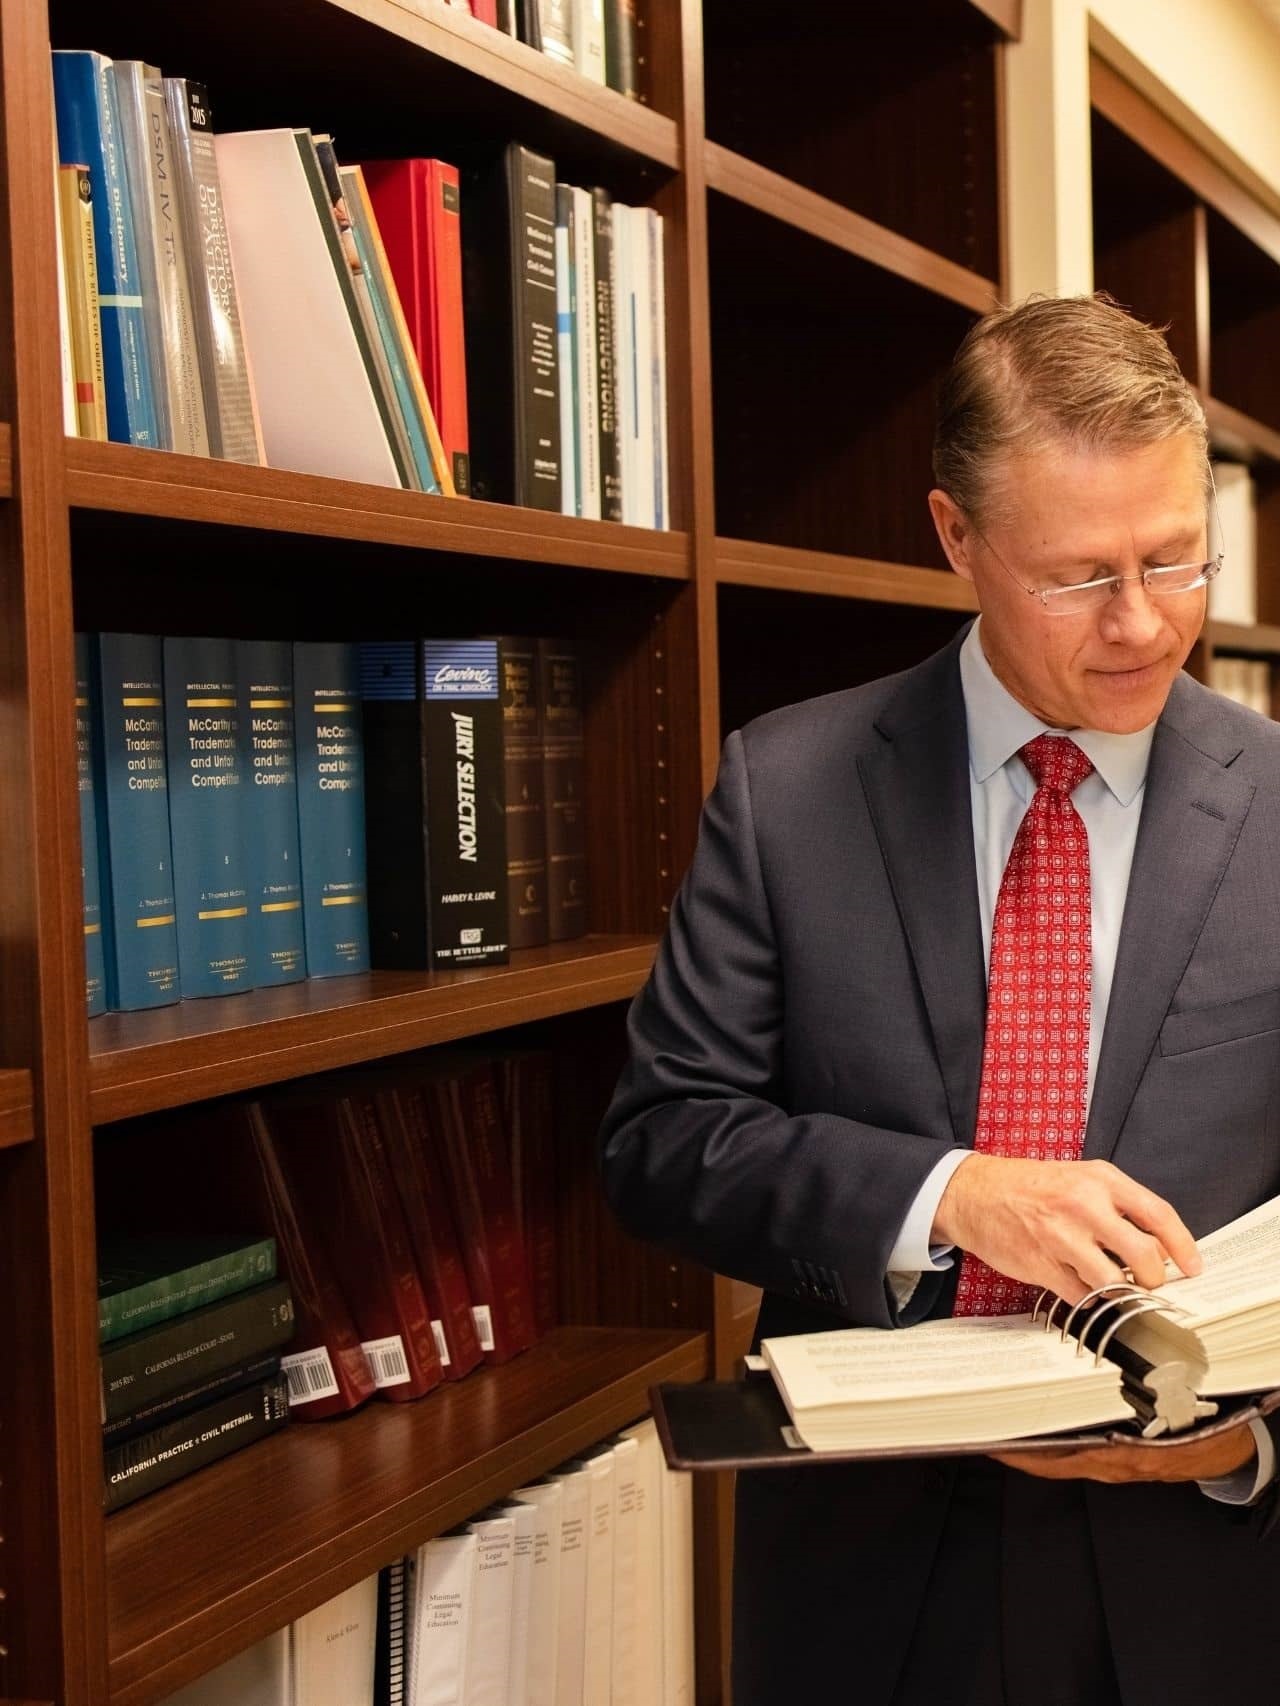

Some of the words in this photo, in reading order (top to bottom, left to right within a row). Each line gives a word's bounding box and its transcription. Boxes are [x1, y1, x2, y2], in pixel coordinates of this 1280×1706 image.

[199, 184, 208, 217] OF
[112, 187, 129, 284] Dictionary
[206, 185, 232, 322] DIRECTORY
[94, 340, 102, 383] ORDER
[434, 664, 493, 684] Levine
[450, 711, 475, 761] JURY
[128, 757, 146, 770] and
[190, 756, 212, 769] and
[254, 755, 273, 768] and
[318, 761, 338, 773] and
[456, 760, 479, 863] SELECTION
[207, 890, 230, 900] Thomas
[474, 890, 497, 902] LEVINE
[209, 957, 246, 969] THOMSON
[111, 1456, 158, 1484] CALIFORNIA
[158, 1439, 194, 1463] PRACTICE
[201, 1428, 221, 1442] CIVIL
[220, 1412, 254, 1434] PRETRIAL
[485, 1551, 503, 1562] Legal
[478, 1560, 509, 1571] Education
[429, 1592, 461, 1602] Minimum
[426, 1601, 462, 1612] Continuing
[434, 1610, 453, 1621] Legal
[427, 1619, 459, 1630] Education
